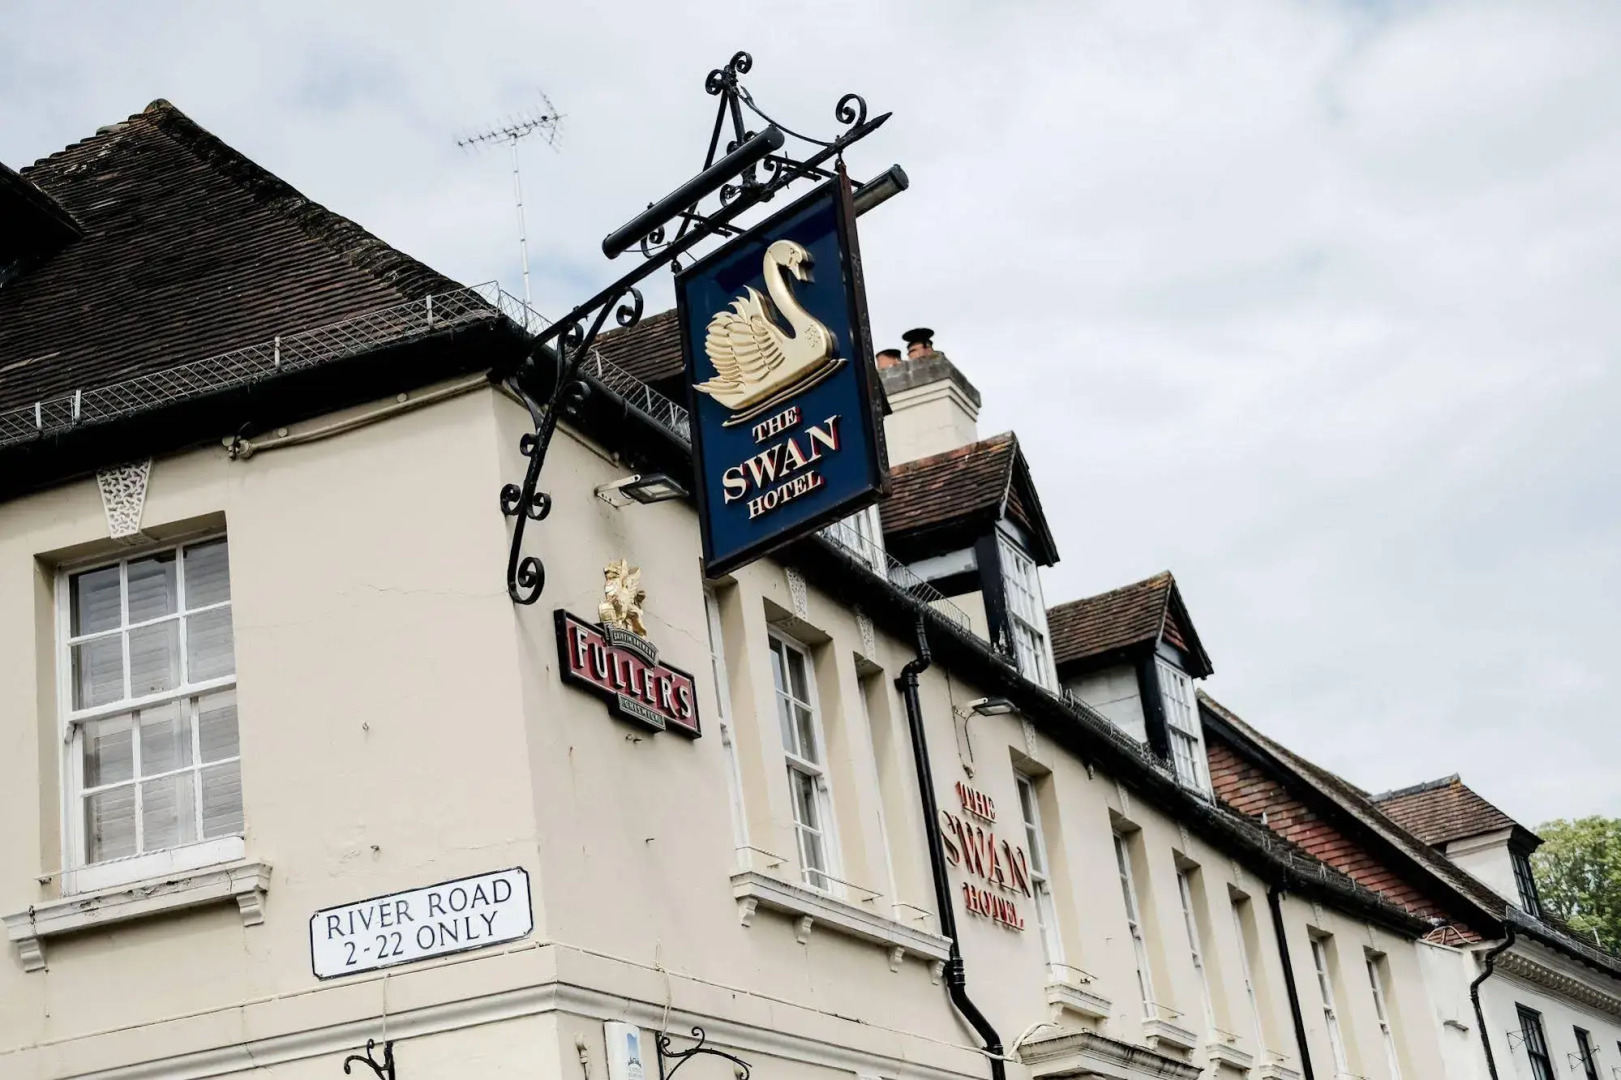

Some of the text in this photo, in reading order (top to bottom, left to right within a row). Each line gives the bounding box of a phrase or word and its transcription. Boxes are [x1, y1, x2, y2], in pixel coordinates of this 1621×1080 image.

[752, 406, 799, 443] THE
[722, 415, 840, 504] SWAN
[747, 470, 823, 519] HOTEL
[570, 626, 692, 718] FULLER'S
[955, 781, 996, 823] THE
[938, 809, 1031, 898] SWAN
[327, 878, 512, 939] RIVER ROAD
[416, 911, 498, 950] ONLY
[963, 881, 1024, 931] HOTEL
